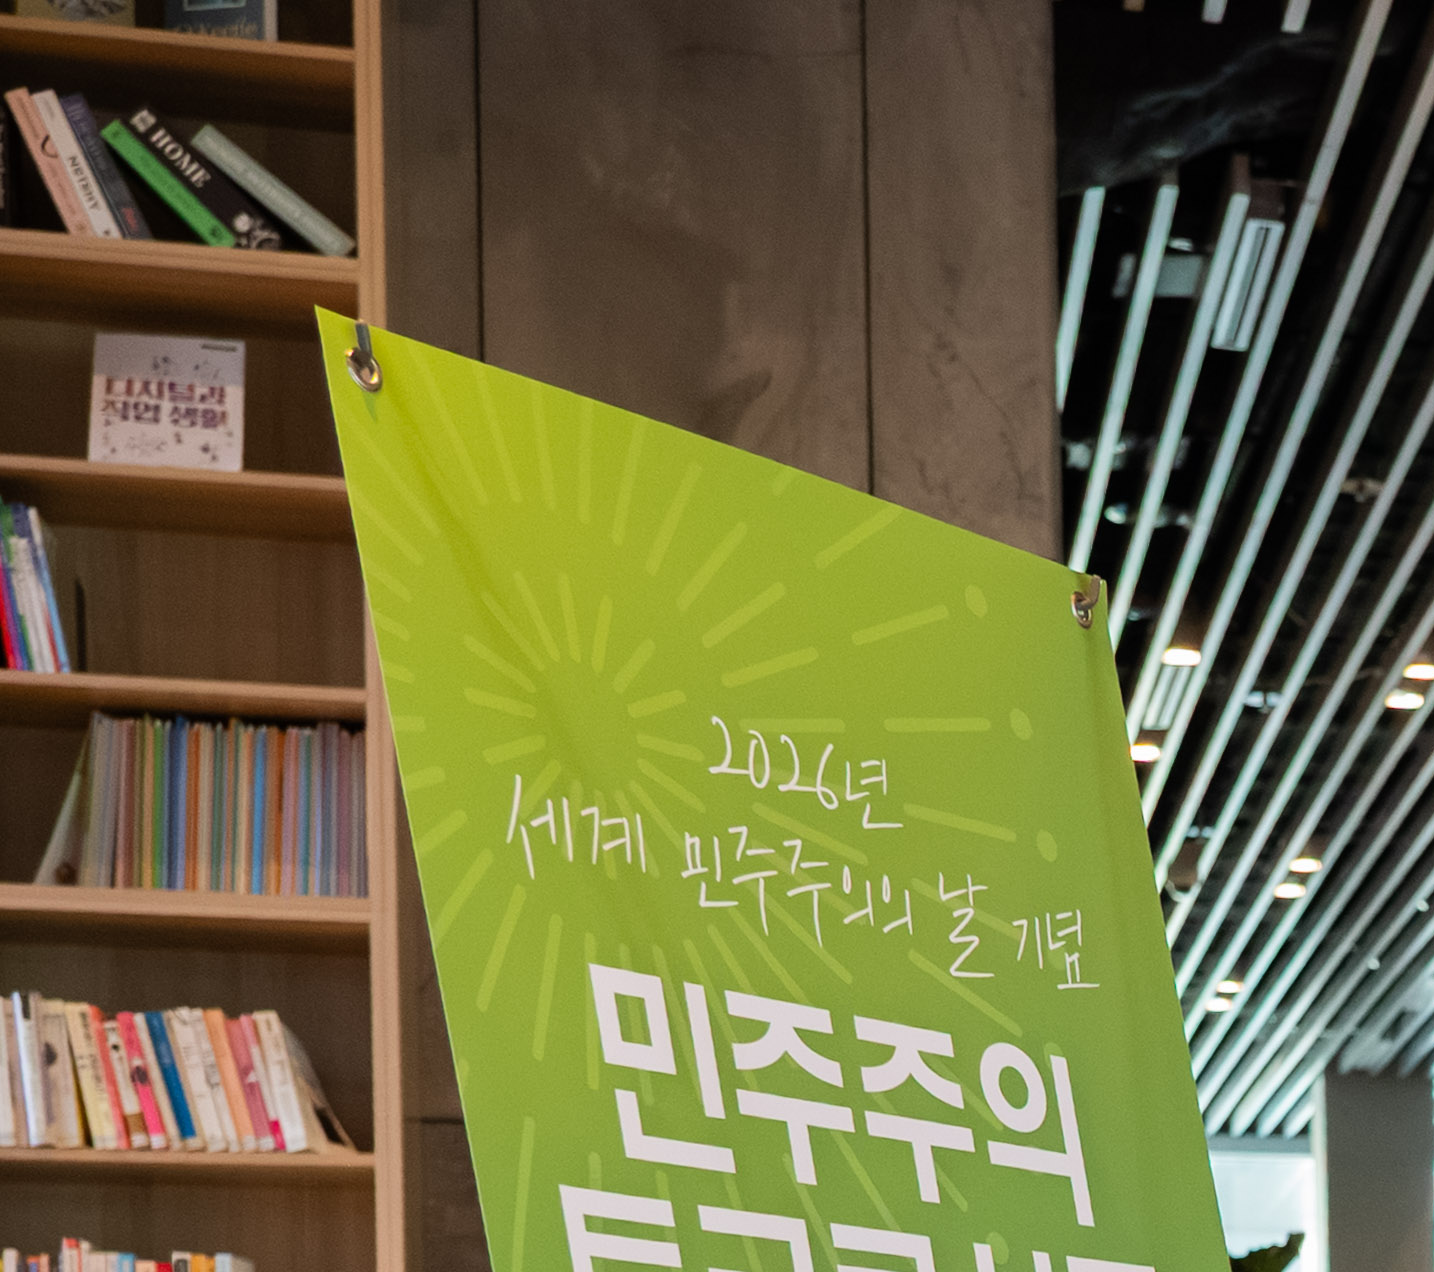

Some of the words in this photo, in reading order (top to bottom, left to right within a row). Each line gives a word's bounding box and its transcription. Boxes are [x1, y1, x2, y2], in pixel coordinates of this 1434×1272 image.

[148, 125, 212, 189] HOME
[708, 716, 903, 829] 2026년
[507, 775, 646, 878] 세계
[681, 826, 914, 946] 민주주의의
[938, 871, 995, 978] 날
[1012, 909, 1099, 990] 기념
[588, 962, 1096, 1228] 민주주의
